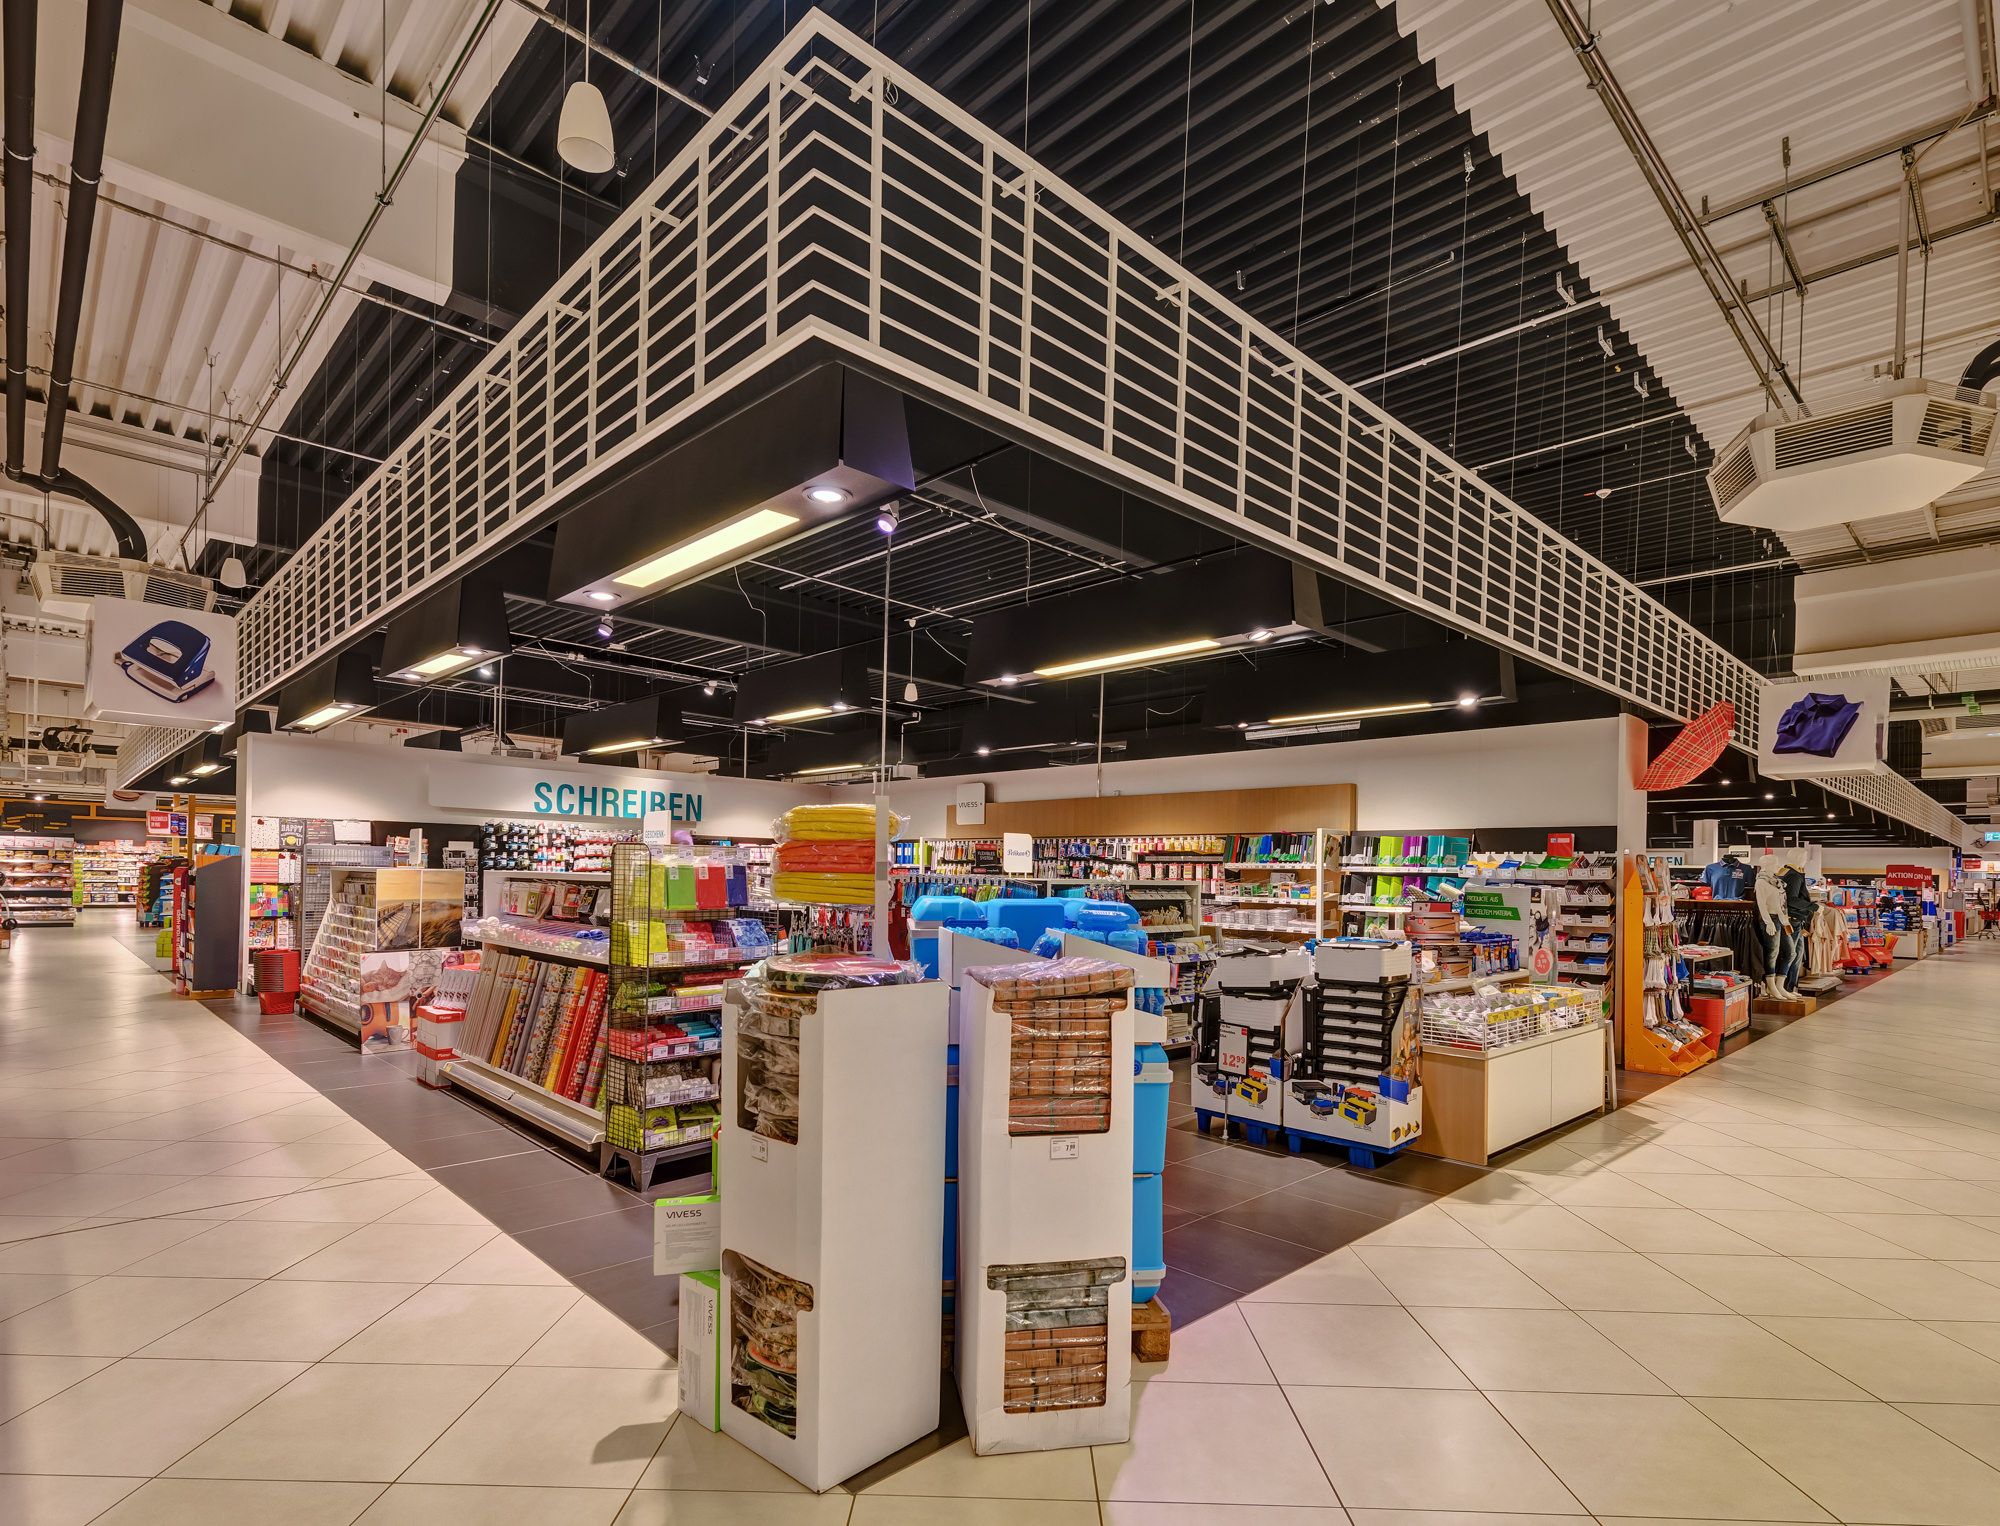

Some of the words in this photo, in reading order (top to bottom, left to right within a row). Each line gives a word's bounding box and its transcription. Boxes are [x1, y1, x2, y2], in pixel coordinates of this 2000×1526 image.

[534, 782, 702, 822] SCHREIBEN
[281, 824, 303, 833] HAPPY
[1466, 895, 1488, 903] PRODUKTE
[1466, 908, 1493, 916] RECYCELTEM
[1493, 909, 1513, 917] MATERIAL
[666, 1209, 702, 1219] VIVESS
